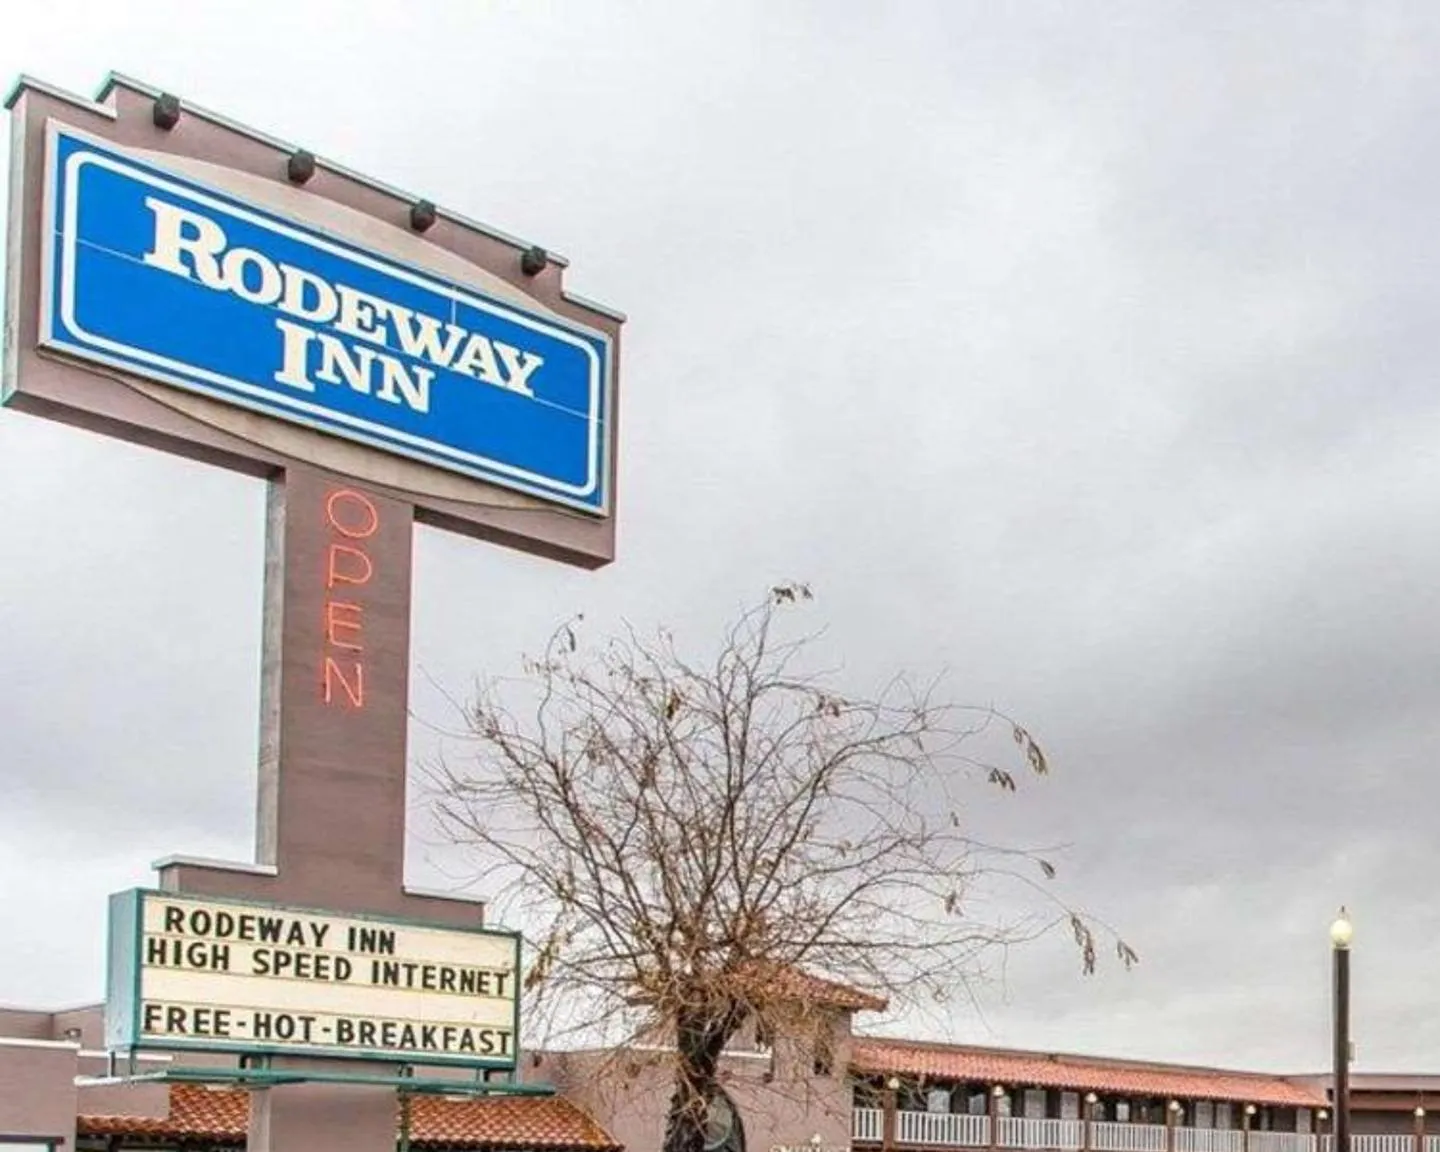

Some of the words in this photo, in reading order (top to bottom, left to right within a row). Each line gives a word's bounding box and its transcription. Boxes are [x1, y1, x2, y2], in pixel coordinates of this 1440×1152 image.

[143, 197, 544, 399] RODEWAY
[274, 318, 436, 414] INN
[324, 489, 379, 709] OPEN
[147, 937, 231, 971] HIGH
[252, 948, 352, 982] SPEED
[371, 962, 510, 997] INTERNET
[165, 905, 330, 948] RODEWAY
[347, 926, 396, 955] INN
